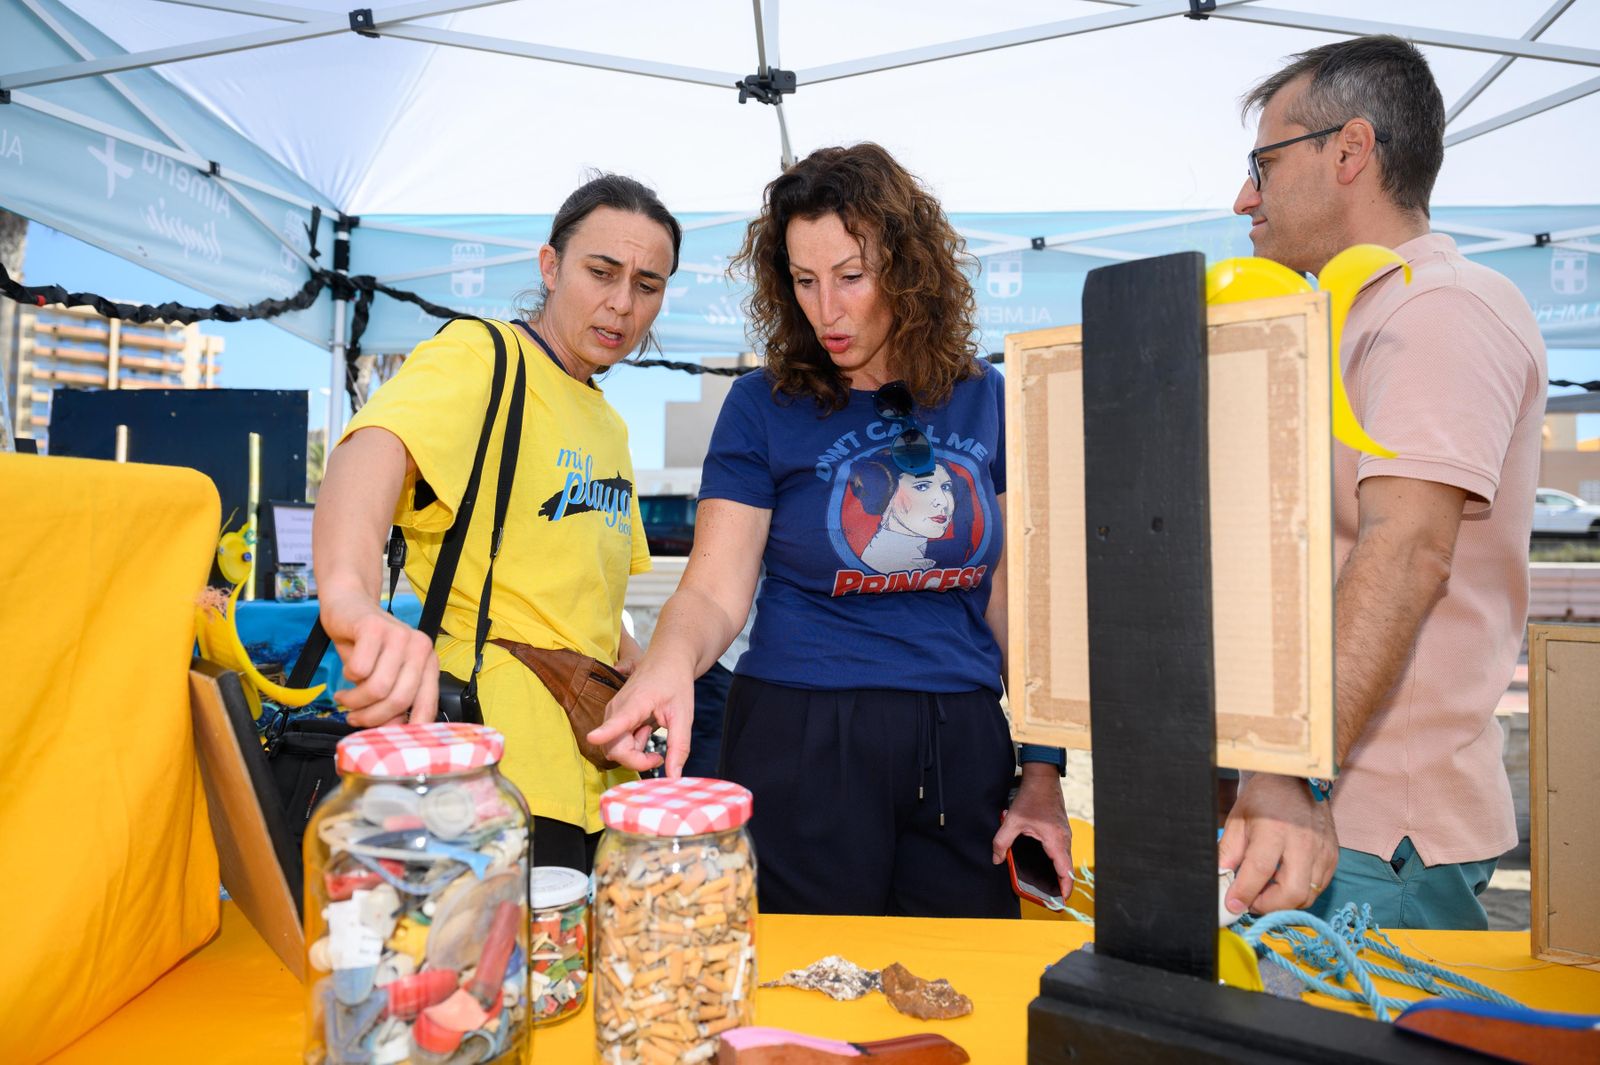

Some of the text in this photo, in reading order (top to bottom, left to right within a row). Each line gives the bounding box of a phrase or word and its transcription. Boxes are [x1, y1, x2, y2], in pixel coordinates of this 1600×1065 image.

[556, 447, 583, 470] mi
[866, 421, 941, 443] CAL
[946, 433, 989, 462] ME
[552, 454, 631, 527] playa
[831, 564, 988, 598] PRINCESS
